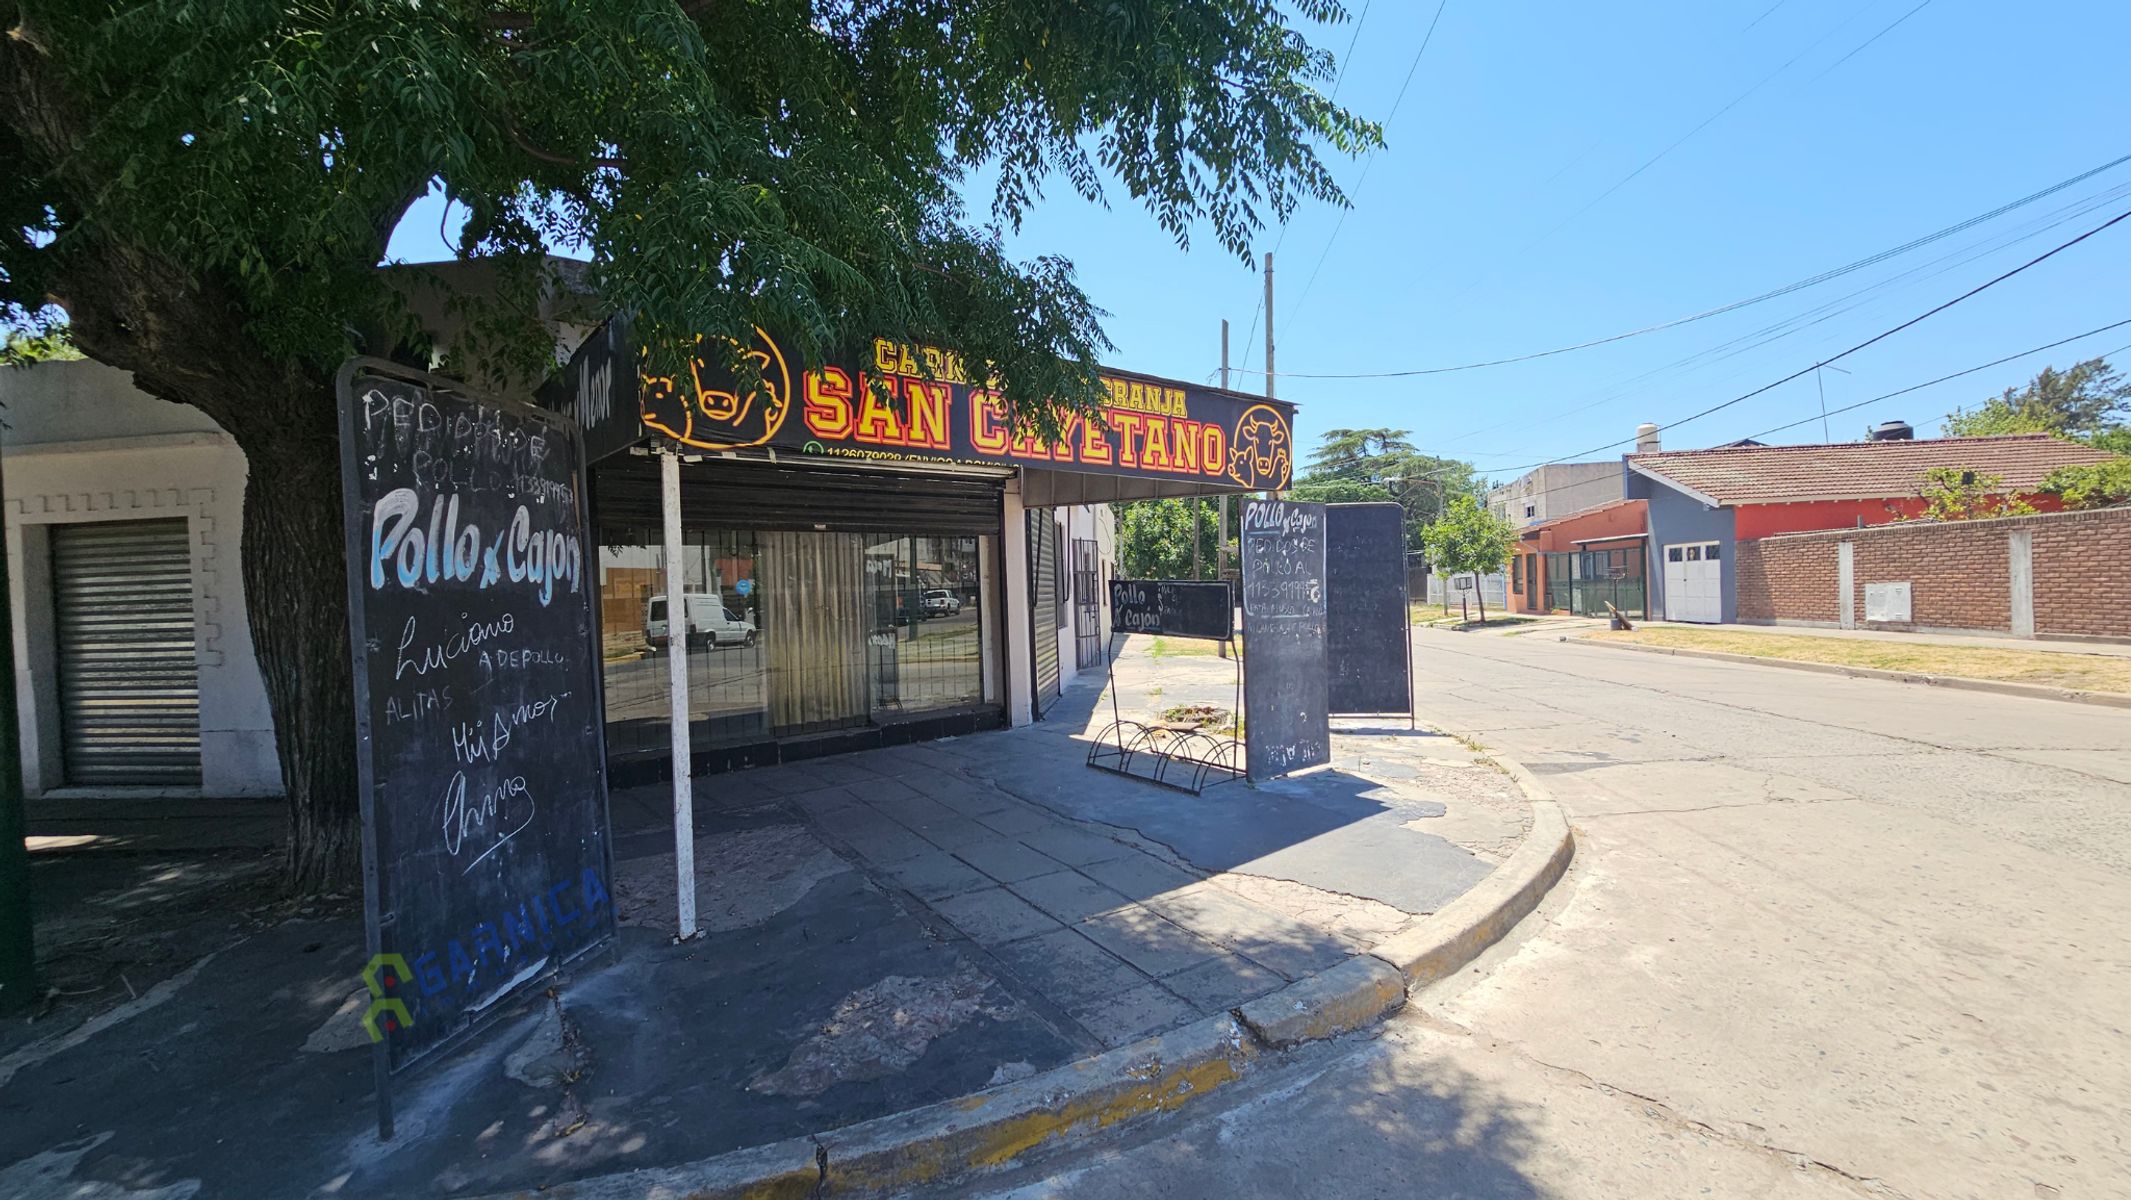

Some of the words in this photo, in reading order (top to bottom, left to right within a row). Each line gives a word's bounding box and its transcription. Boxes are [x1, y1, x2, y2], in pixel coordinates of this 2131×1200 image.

[803, 366, 952, 451] SAN
[1098, 377, 1188, 419] GRANJA
[1245, 502, 1285, 531] POLLO
[371, 488, 480, 591] Pollo
[507, 504, 581, 607] Cajon
[1113, 583, 1146, 607] Pollo
[396, 612, 515, 681] Luciano
[385, 685, 453, 726] ALITAS
